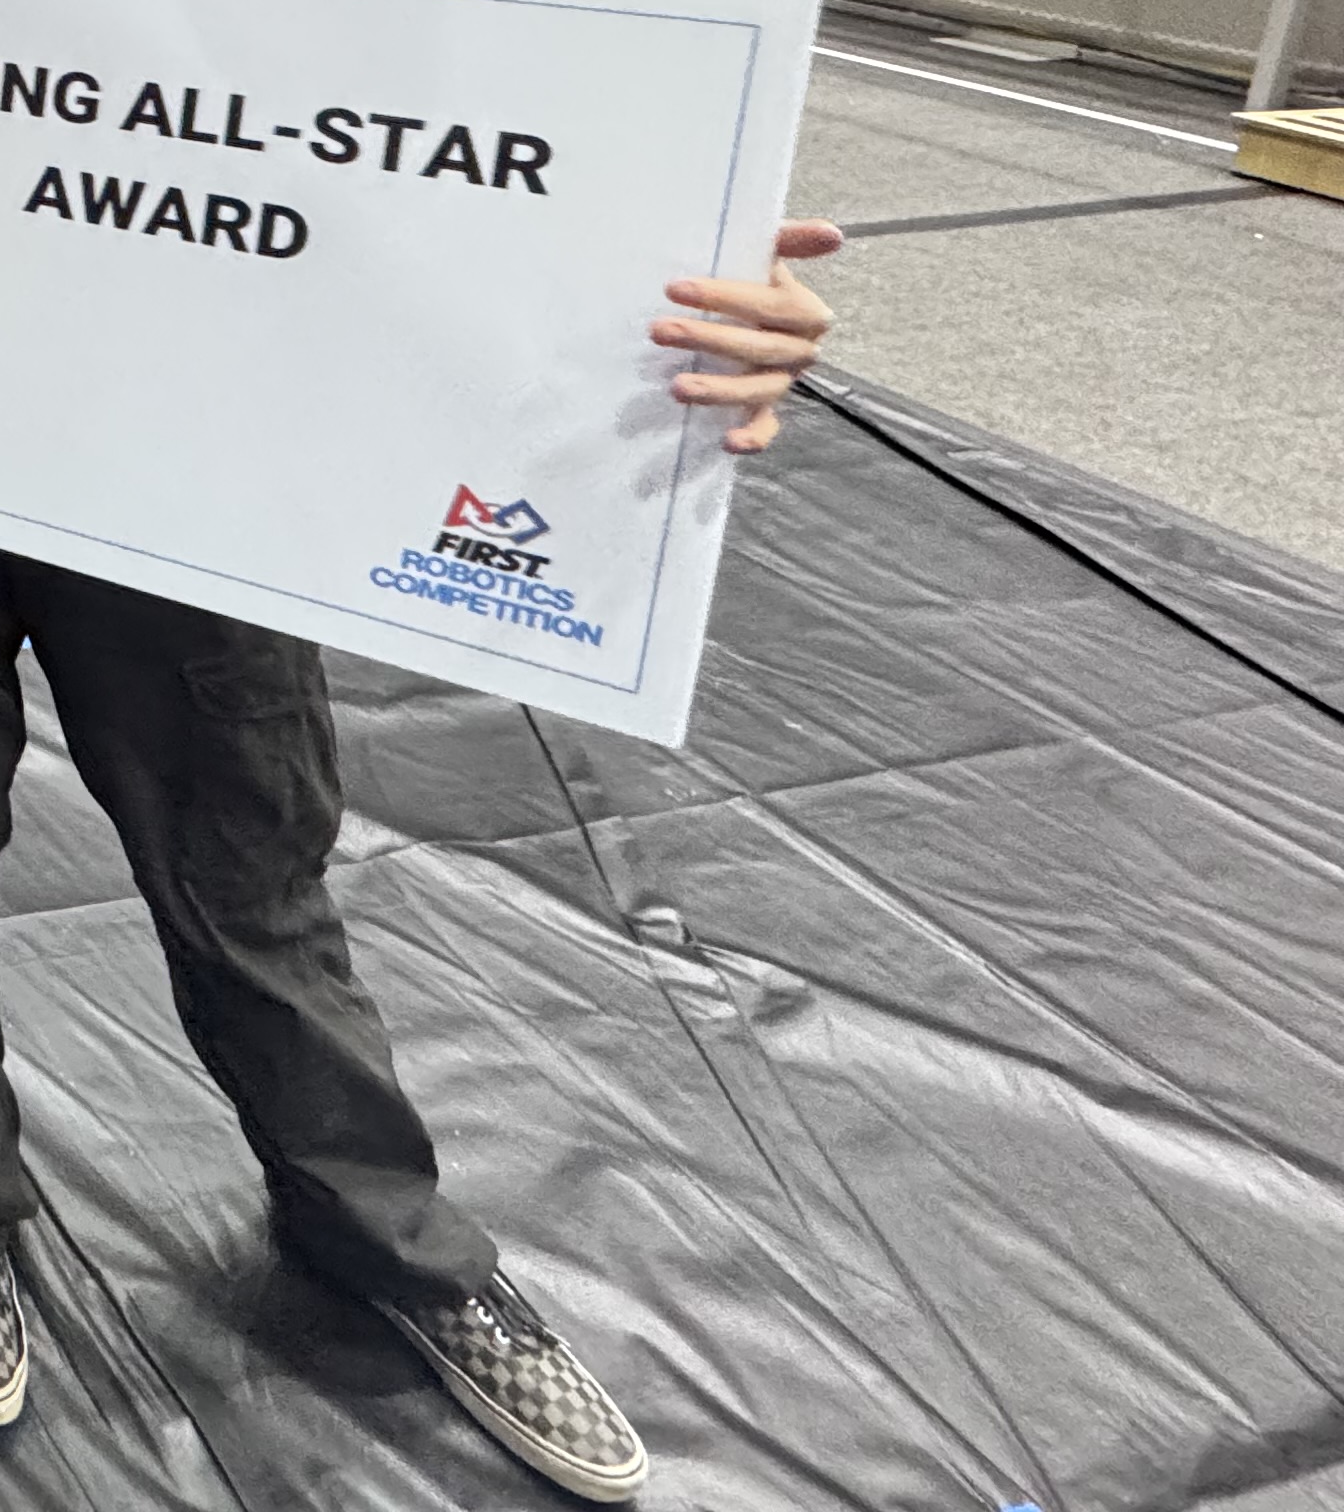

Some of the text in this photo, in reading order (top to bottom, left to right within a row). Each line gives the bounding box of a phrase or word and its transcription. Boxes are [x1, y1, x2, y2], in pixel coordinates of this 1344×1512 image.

[118, 80, 554, 197] ALL-STAR
[22, 165, 310, 261] AWARD
[400, 547, 576, 612] ROBOTICS
[431, 530, 552, 580] FIRST
[369, 566, 604, 647] COMPETITION
